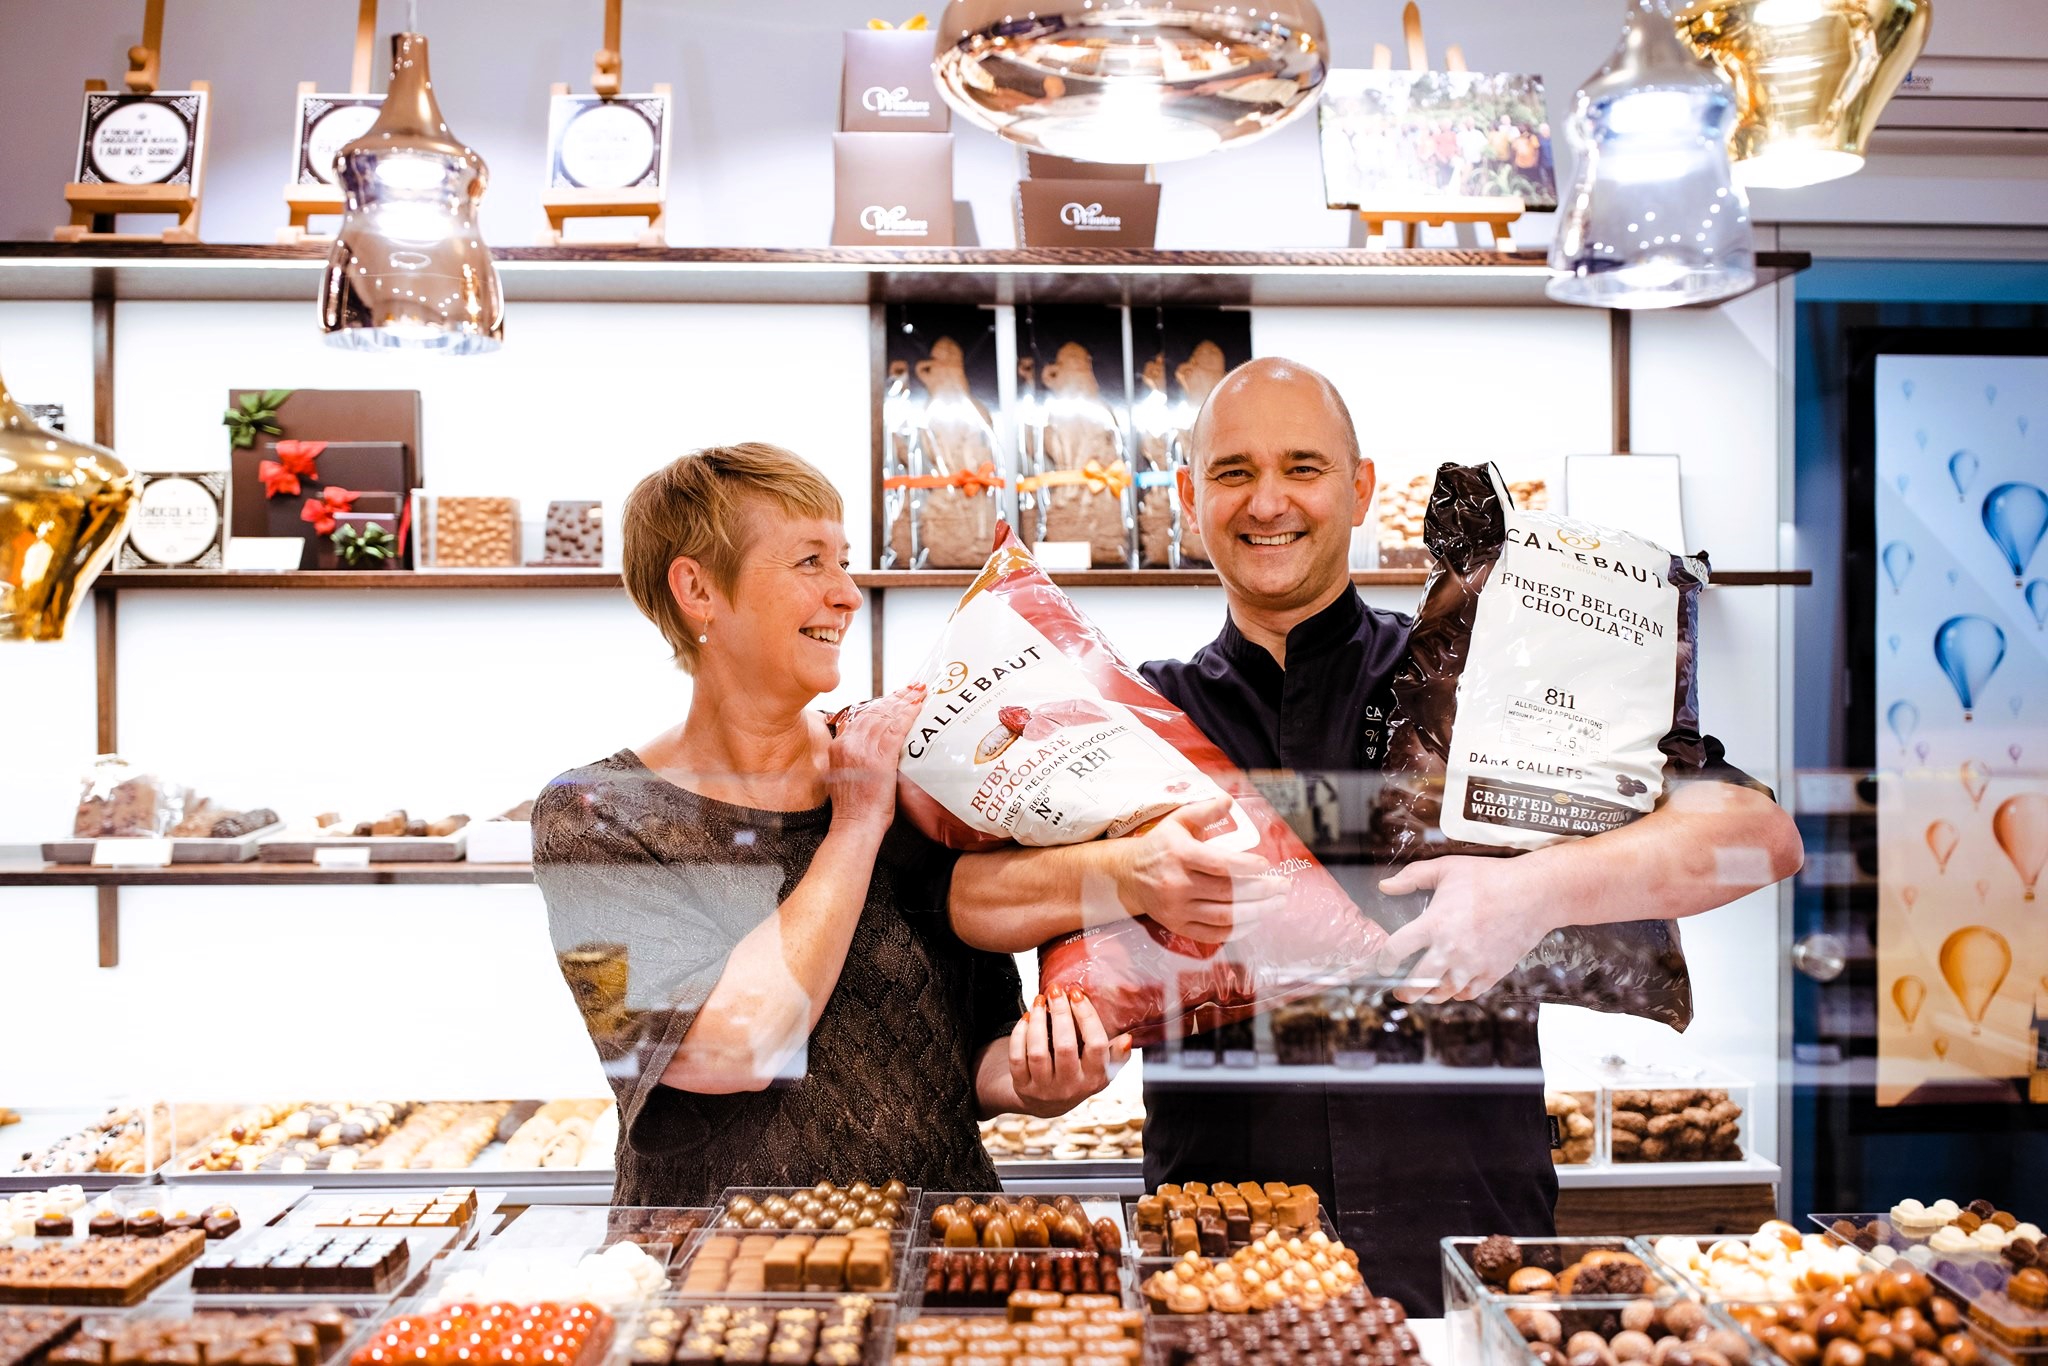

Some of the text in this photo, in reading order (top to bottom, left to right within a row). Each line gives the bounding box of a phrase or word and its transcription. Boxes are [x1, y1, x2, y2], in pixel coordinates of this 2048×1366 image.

[1506, 528, 1663, 588] CALEBAUT
[1501, 573, 1664, 638] FINEST BELGIAN
[1522, 595, 1645, 646] CHOCOLATE
[907, 646, 1041, 759] CALLEBAUT
[1514, 700, 1553, 715] ALLROUND
[1554, 710, 1603, 730] APPLICATIONS
[1544, 688, 1576, 710] 811
[970, 759, 1011, 813] RUBY
[985, 735, 1071, 822] CHOCOLATE
[1001, 794, 1026, 830] FINEST
[1070, 725, 1129, 755] CHOCOLATE
[1472, 790, 1552, 813] CRAFTED
[1471, 803, 1530, 821] WHOLE
[1530, 813, 1569, 829] BEAN
